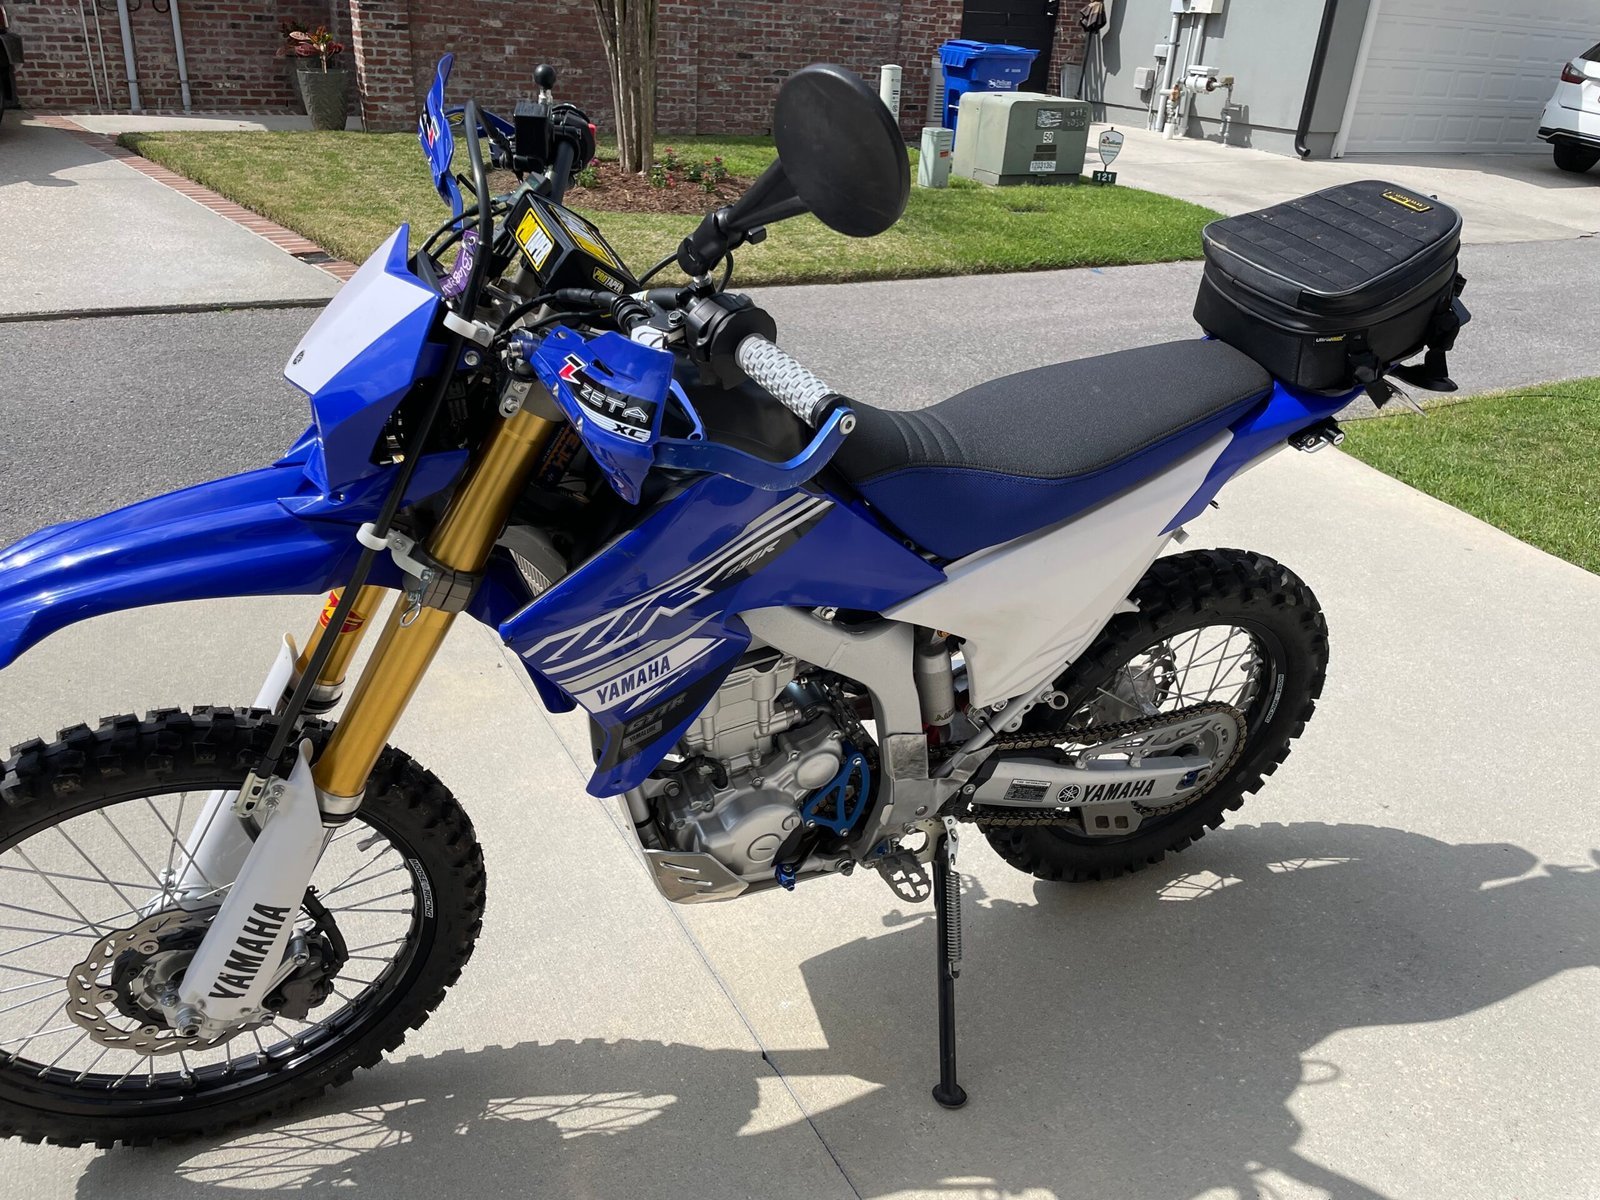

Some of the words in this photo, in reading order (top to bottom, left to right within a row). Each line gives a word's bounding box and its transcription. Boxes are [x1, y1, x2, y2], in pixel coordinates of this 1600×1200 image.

[1096, 172, 1112, 182] 121
[579, 383, 649, 423] ZETA
[613, 423, 648, 441] XC
[721, 538, 781, 581] 250R
[596, 653, 671, 706] YAMAHA
[625, 692, 688, 735] GYTR
[1081, 779, 1156, 803] YAMAHA
[410, 858, 428, 884] MOOSE
[422, 888, 433, 918] RACING
[207, 902, 291, 999] YAMAHA
